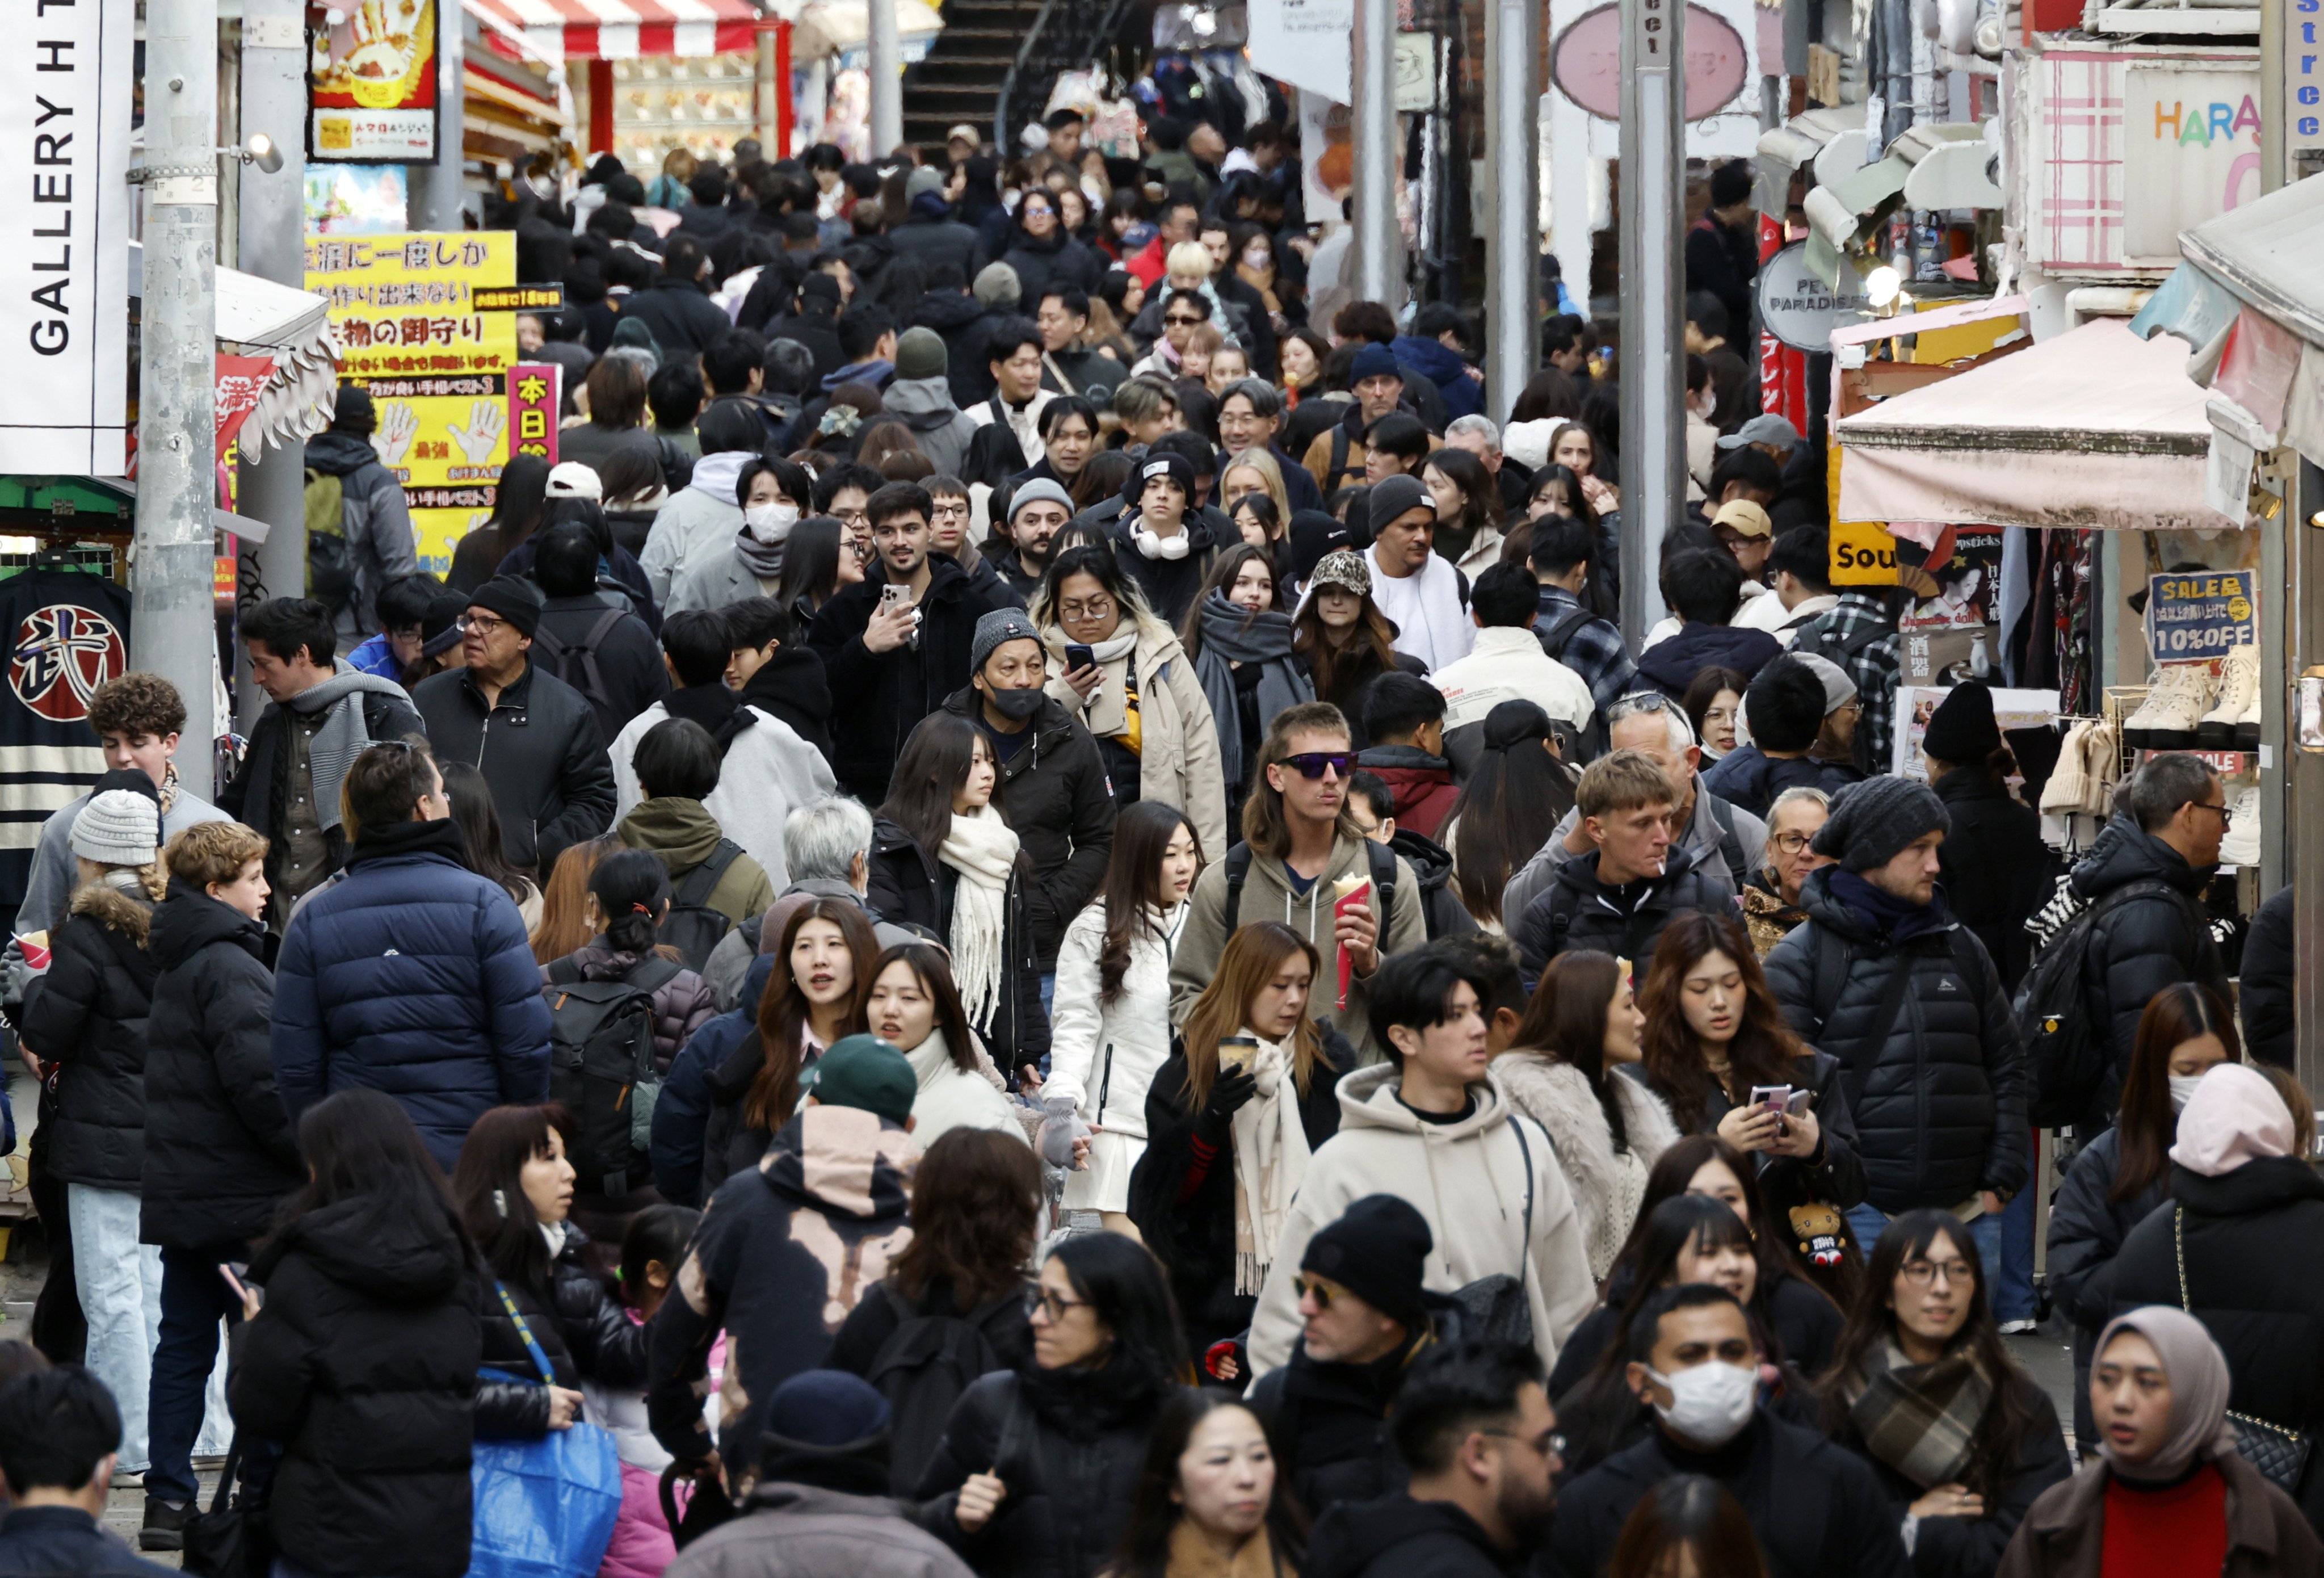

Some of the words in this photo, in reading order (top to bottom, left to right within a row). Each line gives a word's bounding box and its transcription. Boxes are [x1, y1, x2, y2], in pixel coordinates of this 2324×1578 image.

[36, 40, 75, 72] H
[2155, 94, 2261, 148] HARA
[30, 95, 74, 356] GALLERY
[2161, 577, 2242, 600] SALE品
[2156, 625, 2251, 651] 10%OFF
